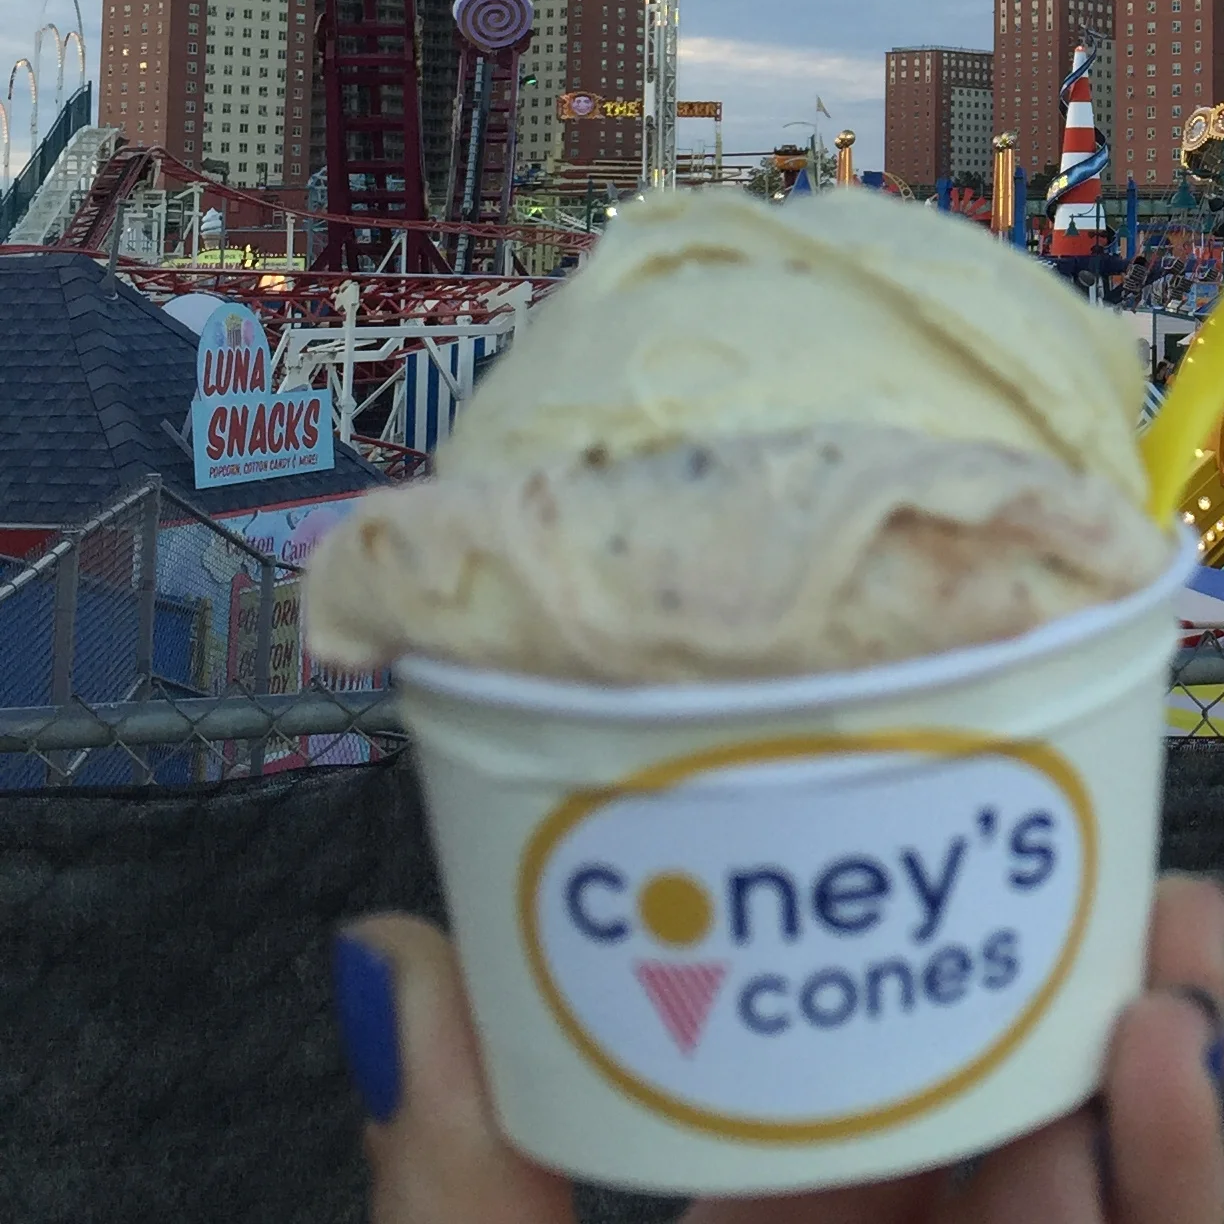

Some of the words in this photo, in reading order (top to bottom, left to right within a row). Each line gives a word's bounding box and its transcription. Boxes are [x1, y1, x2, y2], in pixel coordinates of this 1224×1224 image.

[602, 100, 641, 118] THE
[203, 346, 265, 397] LUNA
[206, 398, 320, 461] SNACKS
[737, 928, 1019, 1037] cones
